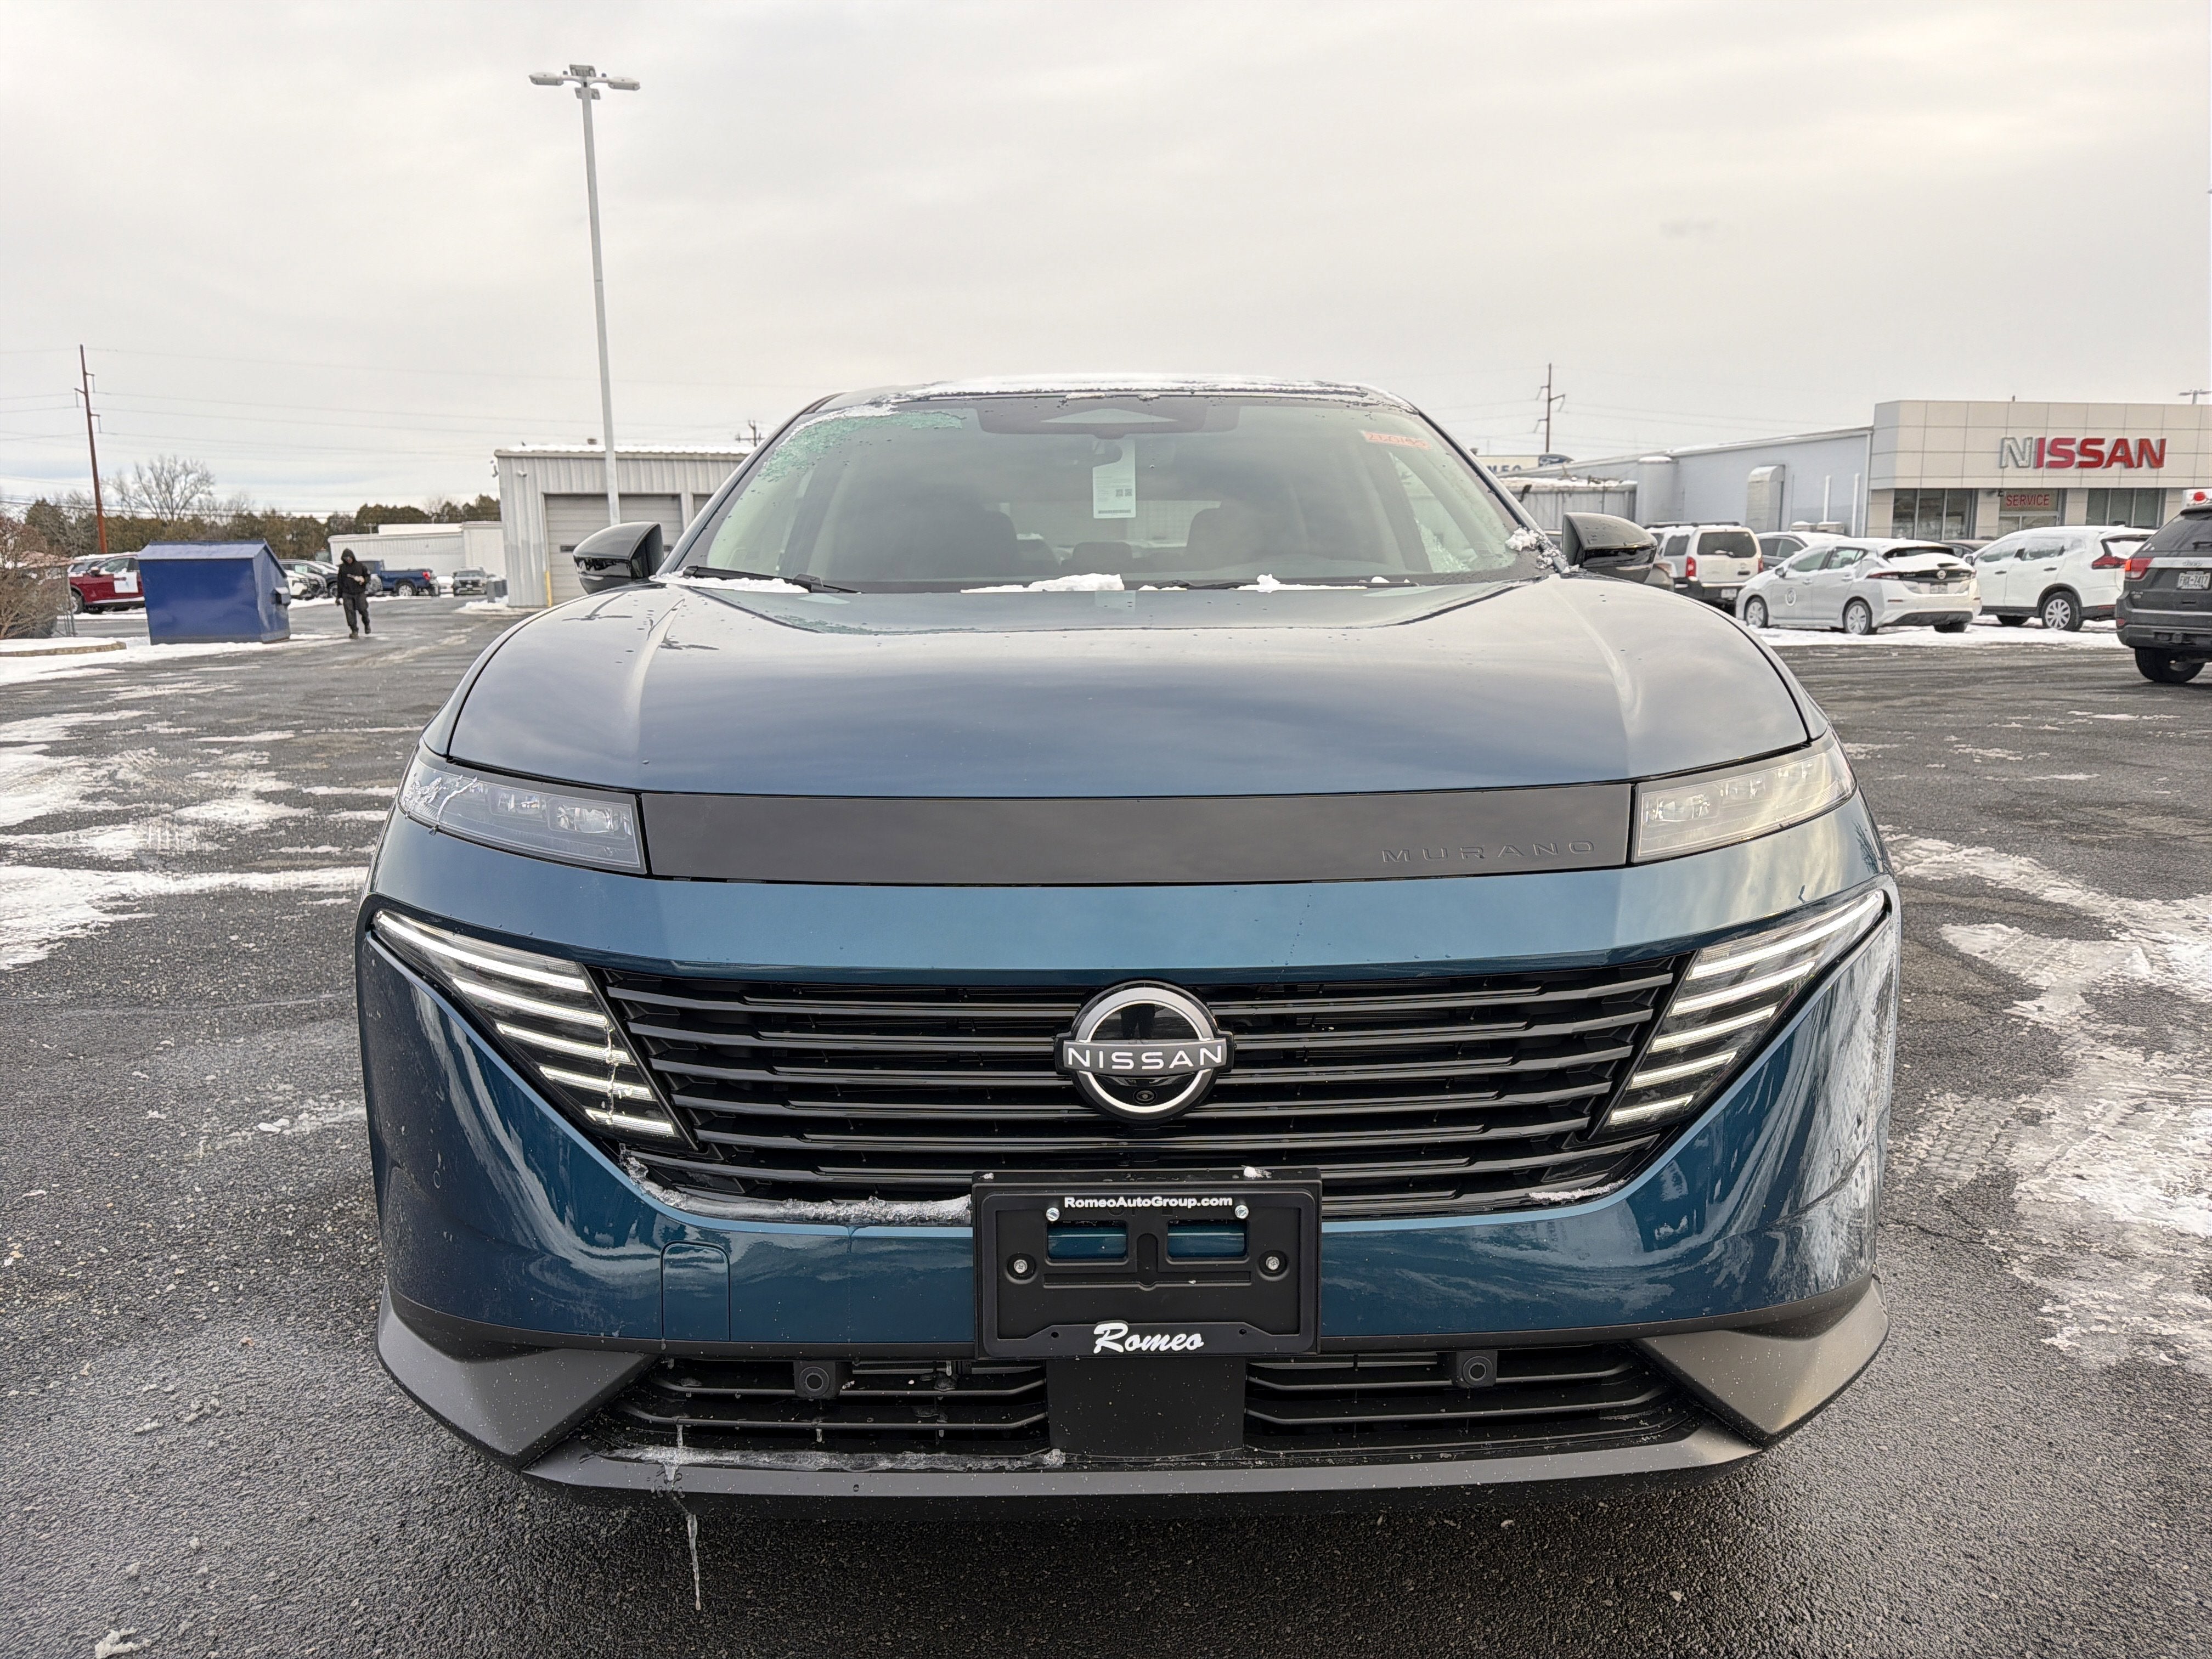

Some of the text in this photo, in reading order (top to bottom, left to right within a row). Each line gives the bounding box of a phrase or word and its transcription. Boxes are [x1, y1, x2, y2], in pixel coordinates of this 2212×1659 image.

[2001, 437, 2166, 468] NISSAN
[2006, 494, 2050, 506] SERVICE
[1382, 840, 1594, 862] MURANO
[1068, 1045, 1222, 1070] NISSAN
[1064, 1197, 1233, 1208] RomeoAutoGroup.com
[1093, 1323, 1204, 1353] Romeo
